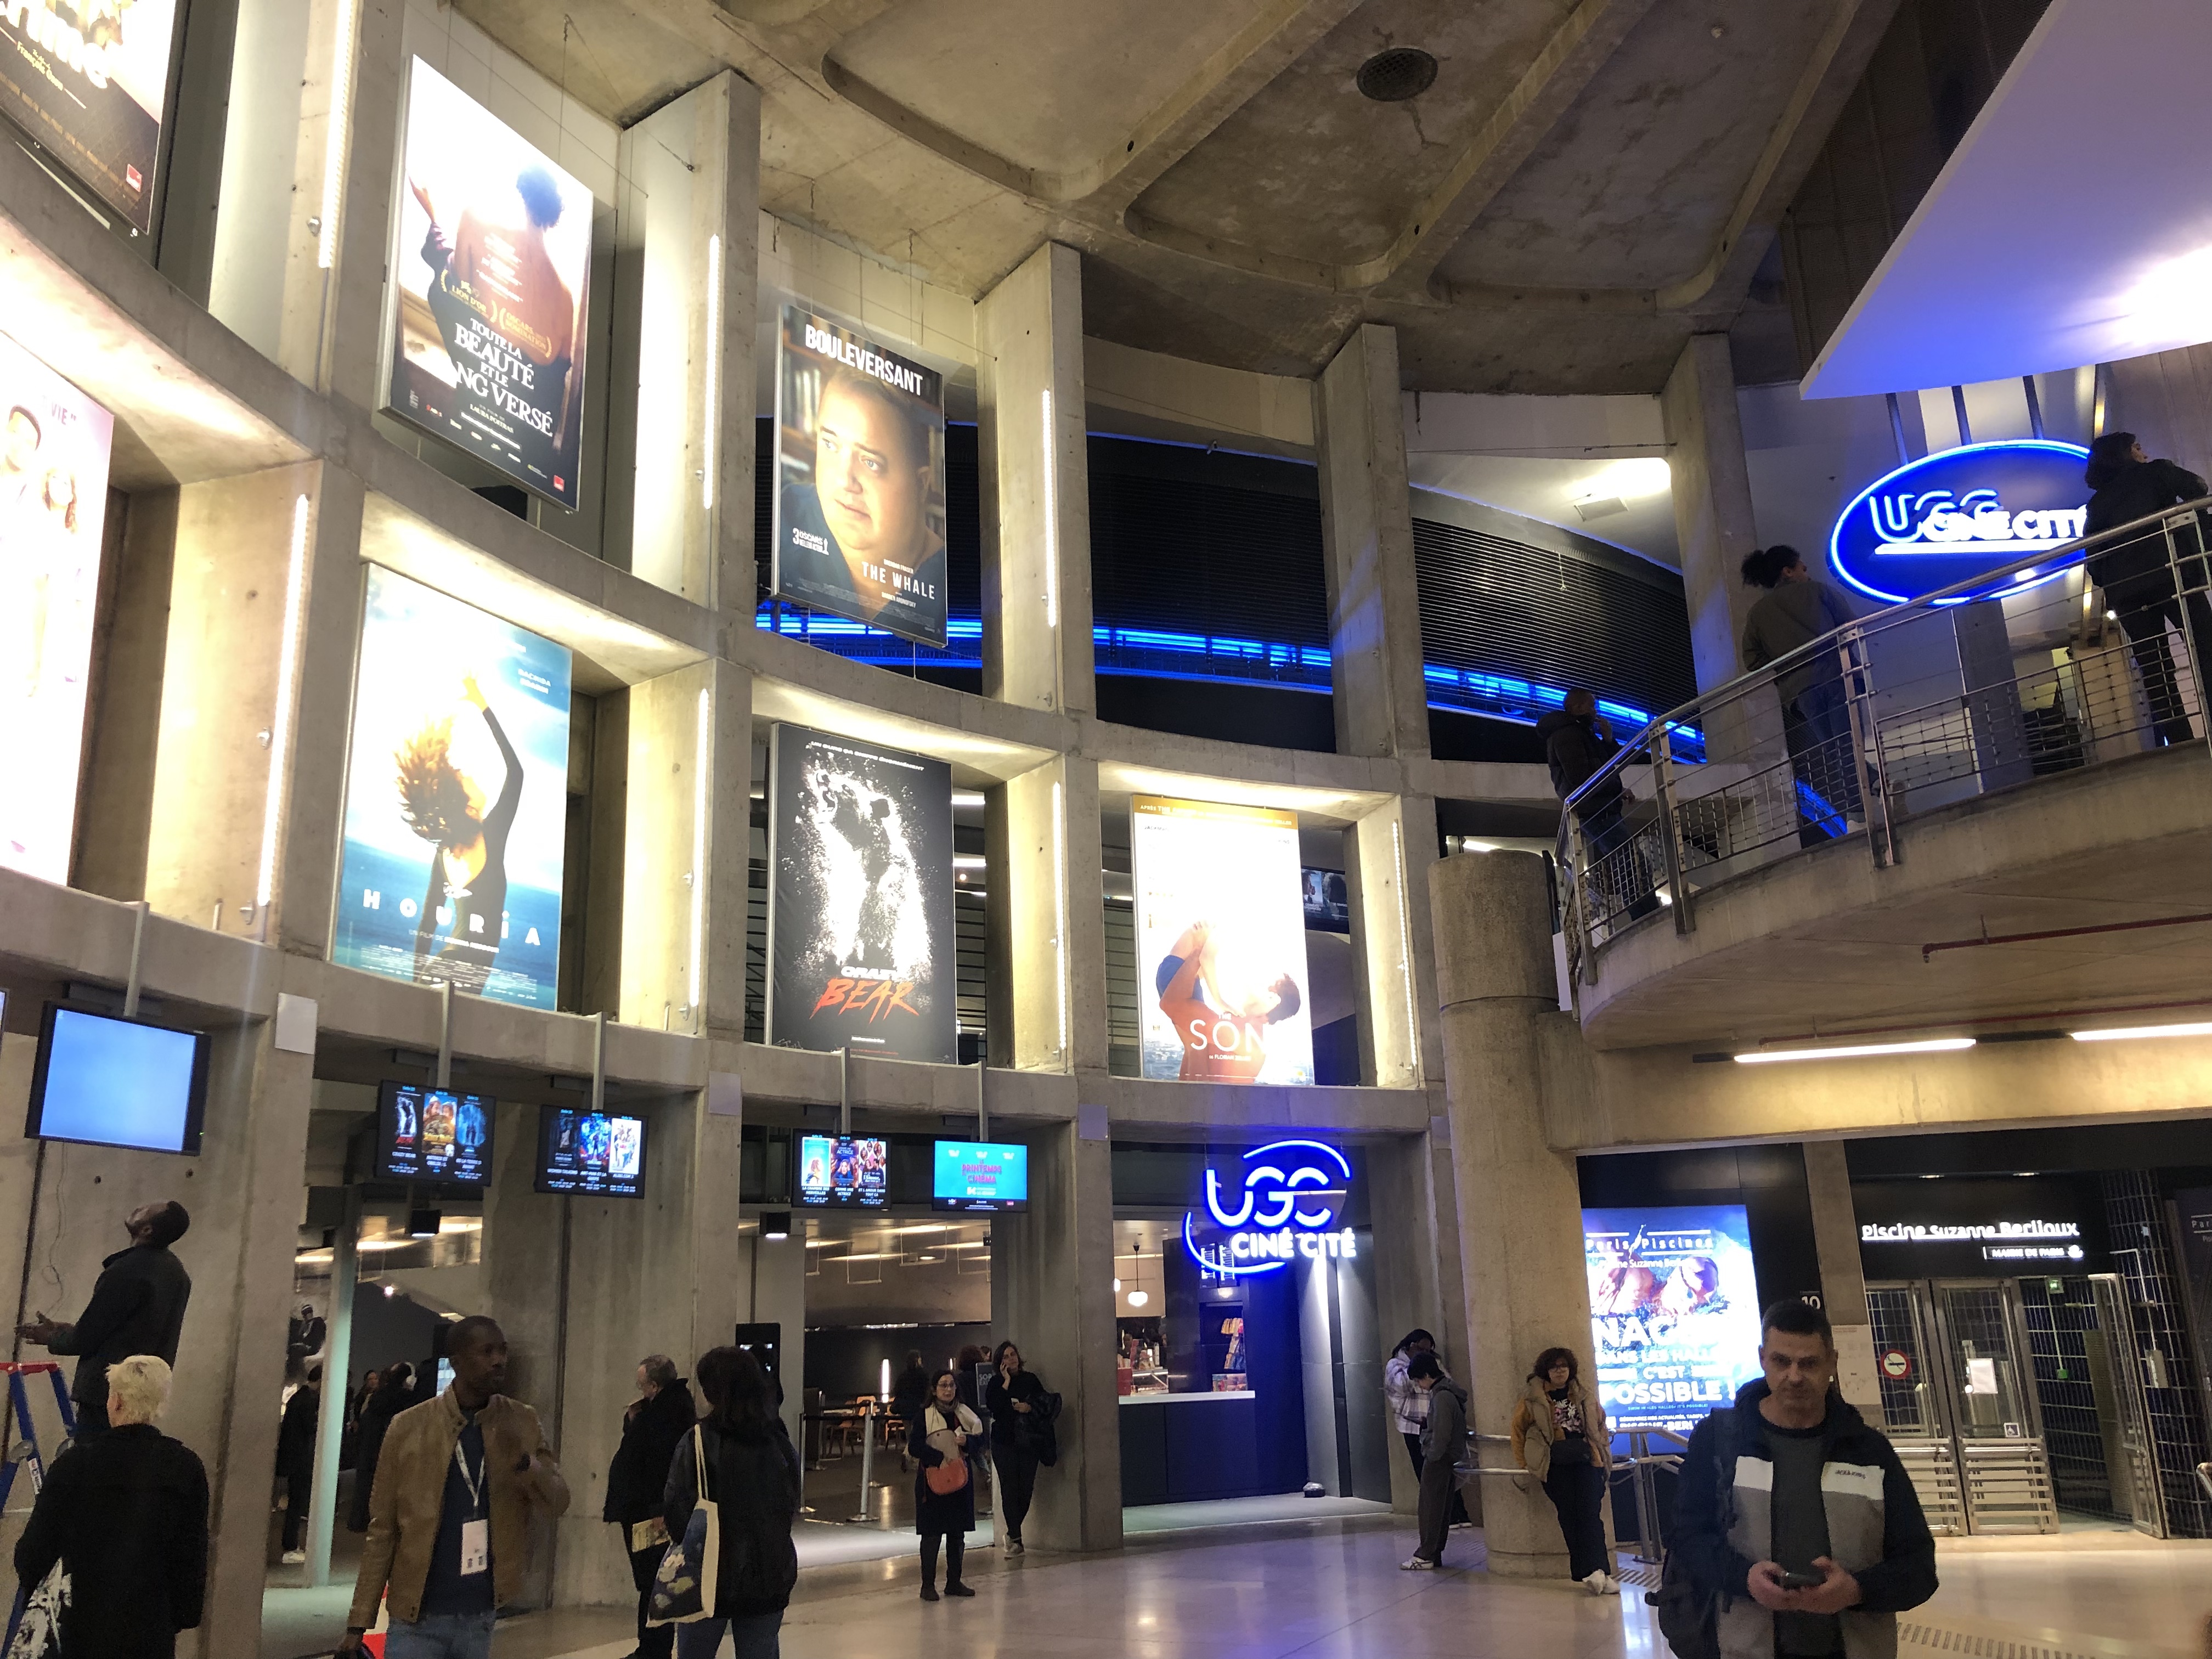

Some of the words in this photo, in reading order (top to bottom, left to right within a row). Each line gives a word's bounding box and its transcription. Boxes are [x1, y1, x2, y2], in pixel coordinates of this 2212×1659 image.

[452, 285, 469, 301] LION
[470, 297, 487, 313] D'OR
[470, 317, 507, 350] TOUTE
[508, 342, 522, 360] LA
[454, 323, 534, 390] BEAUTÉ
[805, 323, 923, 396] BOULEVERSANT
[481, 361, 494, 377] ET
[495, 371, 509, 388] LE
[52, 402, 67, 425] VIE
[490, 382, 553, 437] VERSÉ
[792, 527, 799, 545] 3
[799, 531, 823, 545] OSCARS
[861, 561, 887, 584] THE
[892, 572, 935, 600] WHALE
[809, 977, 919, 1024] BEAR
[1189, 1019, 1266, 1054] SON
[962, 1164, 1002, 1175] PRINTEMPS
[967, 1174, 997, 1184] CINÉMA
[1205, 1166, 1332, 1227] UGC
[1861, 1222, 1926, 1239] Piscine
[1929, 1224, 1995, 1237] Suzanne
[2000, 1220, 2080, 1237] Berlioux
[1231, 1227, 1295, 1259] CINÉ
[1299, 1227, 1357, 1259] CITÉ
[1585, 1238, 1629, 1251] Paris
[1641, 1237, 1713, 1250] Piscines
[2024, 1248, 2038, 1257] DE
[2039, 1248, 2064, 1257] PARIS
[1629, 1259, 1663, 1268] Suzanne
[1801, 1295, 1821, 1310] 10
[1642, 1365, 1686, 1380] C'EST
[1598, 1380, 1723, 1405] POSSIBLE
